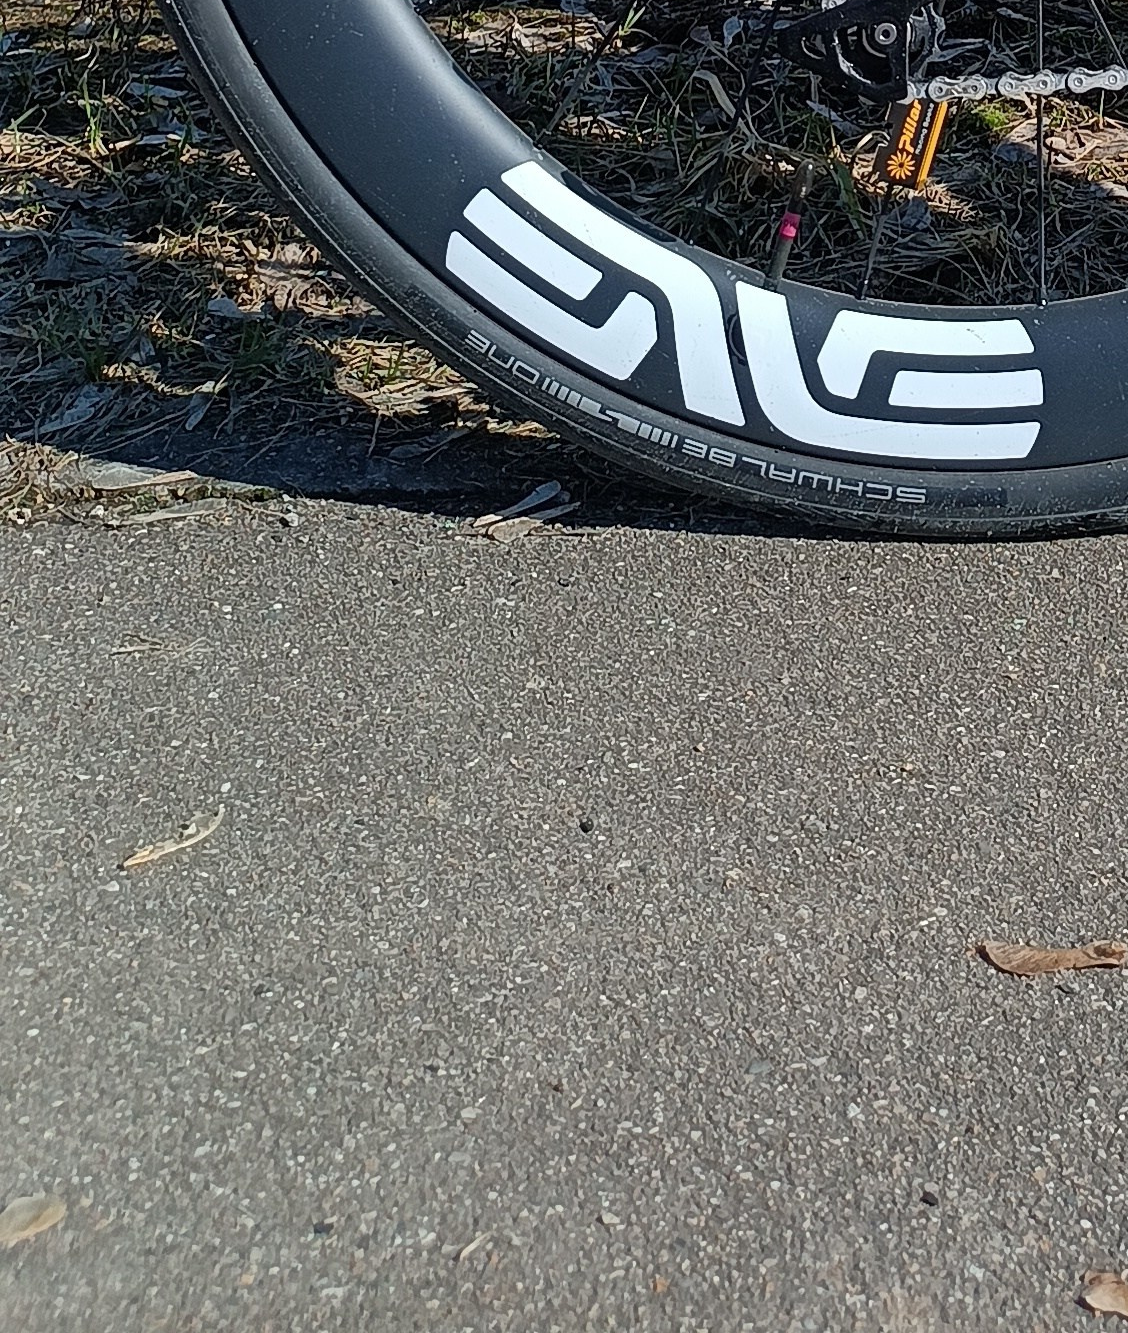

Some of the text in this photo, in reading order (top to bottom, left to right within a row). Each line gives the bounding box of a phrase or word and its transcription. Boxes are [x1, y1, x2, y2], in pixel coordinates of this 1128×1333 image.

[897, 97, 926, 154] Pillar
[463, 329, 928, 506] SCHWALBE ONE
